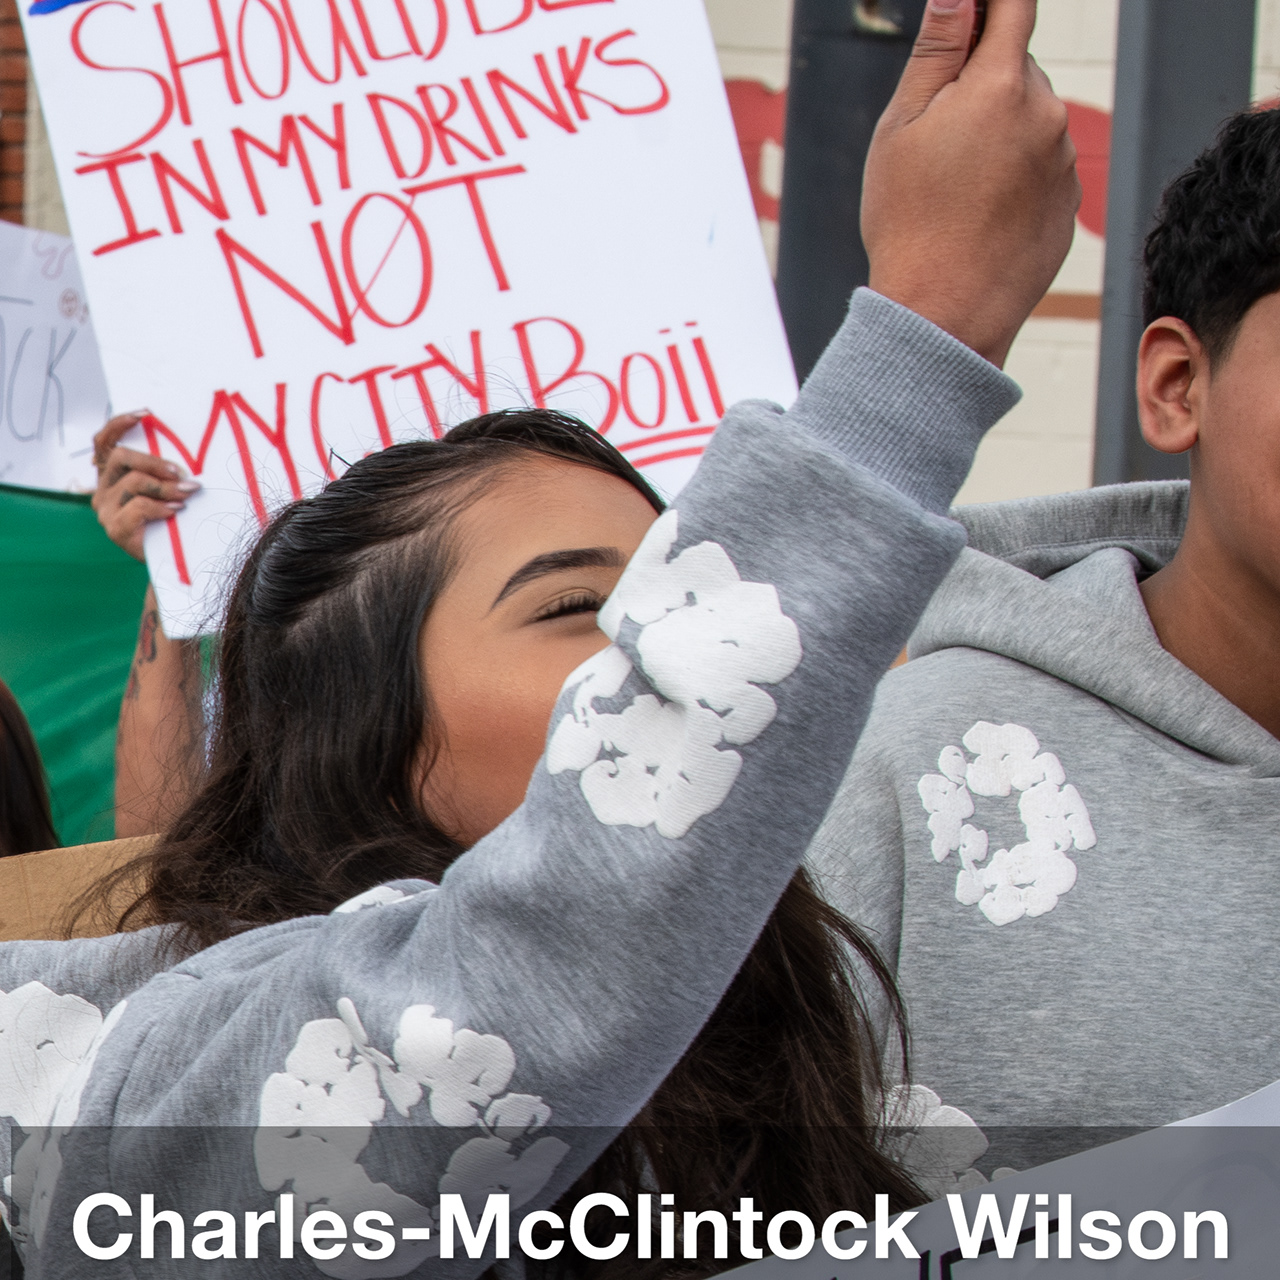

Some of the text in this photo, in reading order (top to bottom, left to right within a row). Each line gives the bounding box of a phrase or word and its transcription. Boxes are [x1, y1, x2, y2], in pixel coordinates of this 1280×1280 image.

[75, 28, 671, 256] IN MY DRINKS
[215, 164, 528, 359] NOT
[140, 382, 303, 585] MY
[309, 330, 490, 480] CITY
